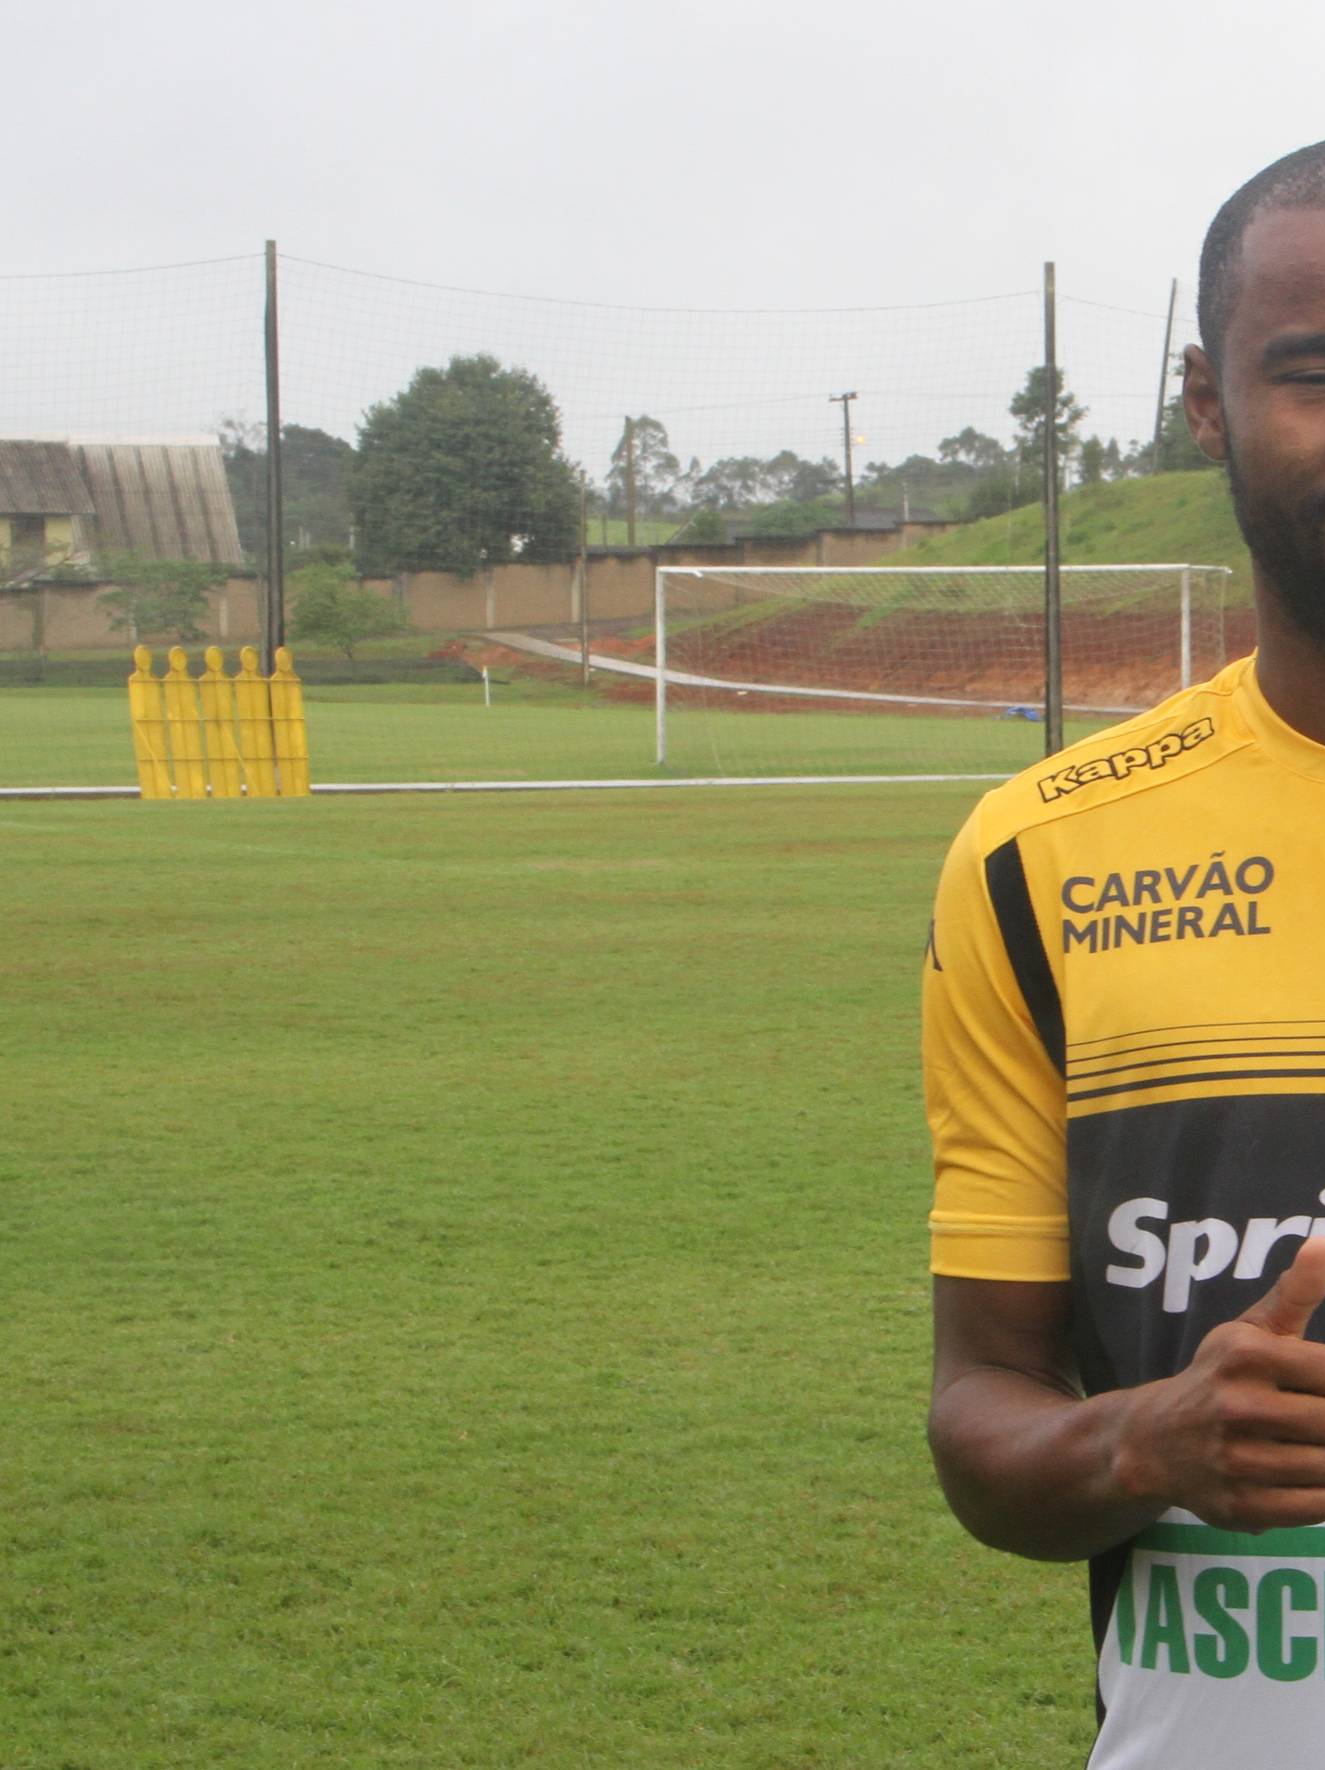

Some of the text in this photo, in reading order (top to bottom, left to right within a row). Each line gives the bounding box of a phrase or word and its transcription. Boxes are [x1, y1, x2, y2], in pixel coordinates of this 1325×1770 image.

[1036, 716, 1215, 803] Kappa
[1060, 850, 1275, 914] CARVÃO
[1062, 901, 1271, 954] MINERAL
